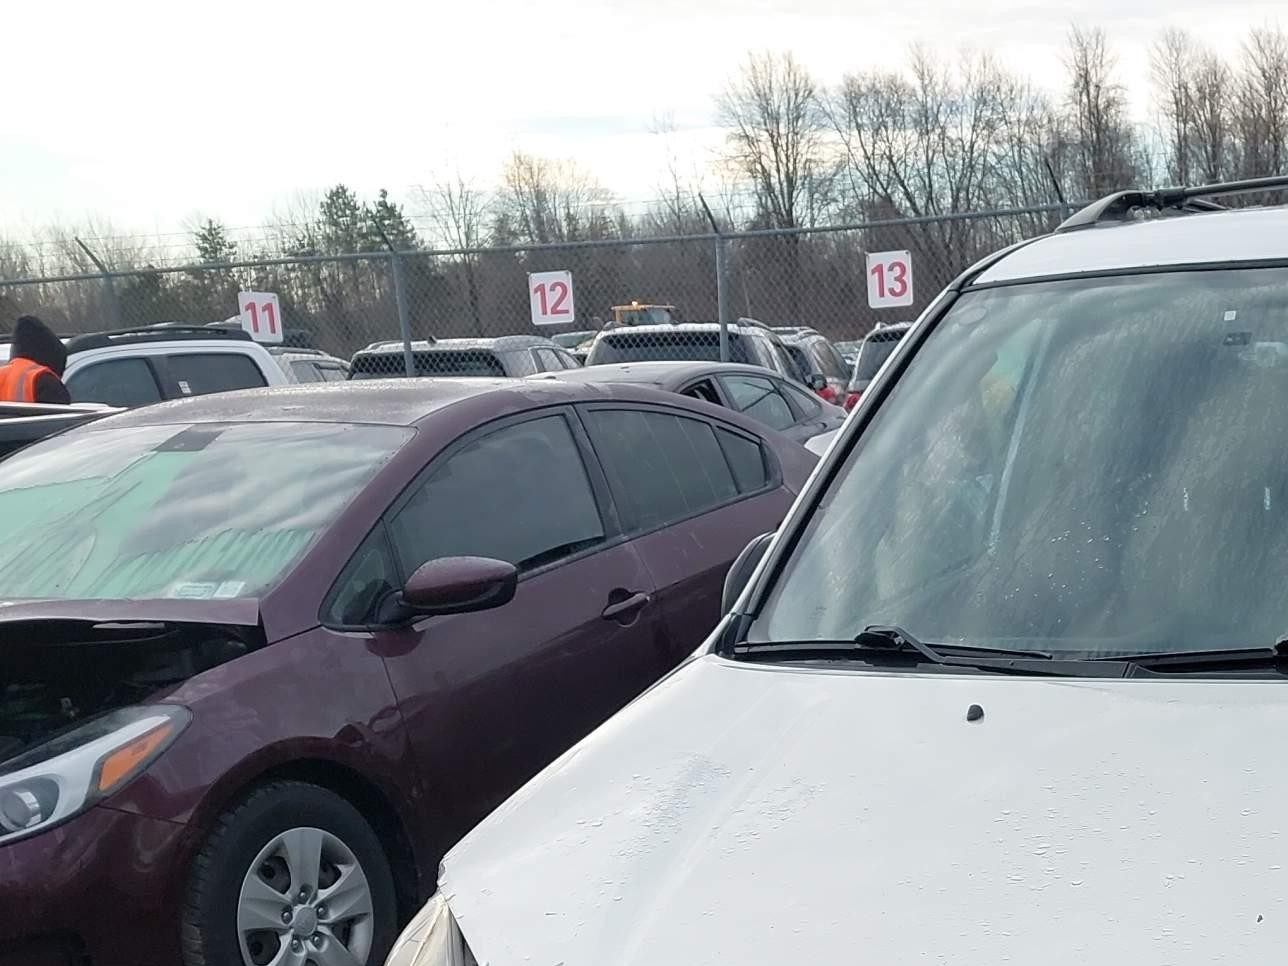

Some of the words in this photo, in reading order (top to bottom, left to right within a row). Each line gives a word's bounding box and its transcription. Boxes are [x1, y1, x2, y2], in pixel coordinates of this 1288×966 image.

[871, 261, 907, 298] 13
[534, 281, 569, 315] 12
[244, 302, 276, 334] 11
